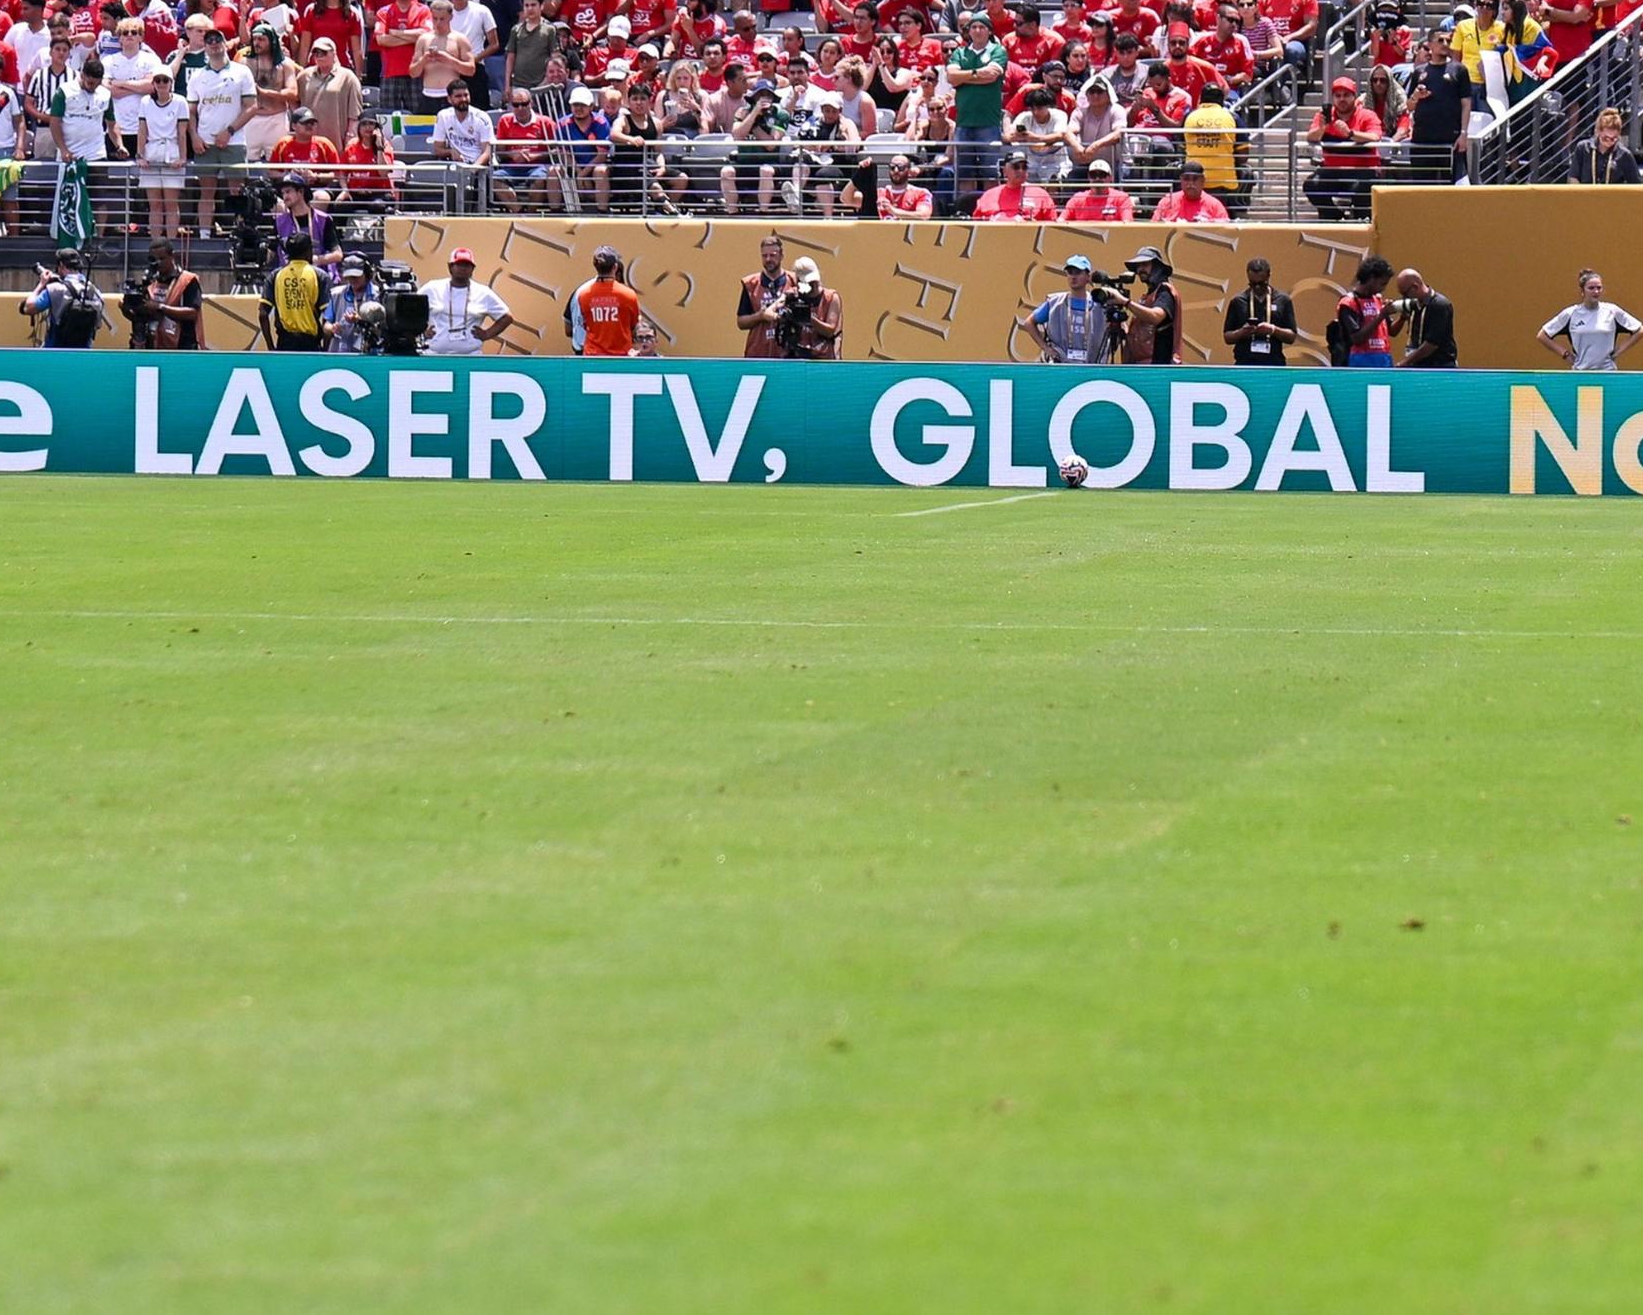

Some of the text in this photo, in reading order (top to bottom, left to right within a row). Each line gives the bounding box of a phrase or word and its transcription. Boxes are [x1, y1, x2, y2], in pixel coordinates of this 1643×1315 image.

[284, 278, 306, 288] CSC
[590, 306, 619, 323] 1072
[135, 367, 548, 480] LASER
[581, 373, 789, 484] TV,
[869, 377, 1425, 491] GLOBAL
